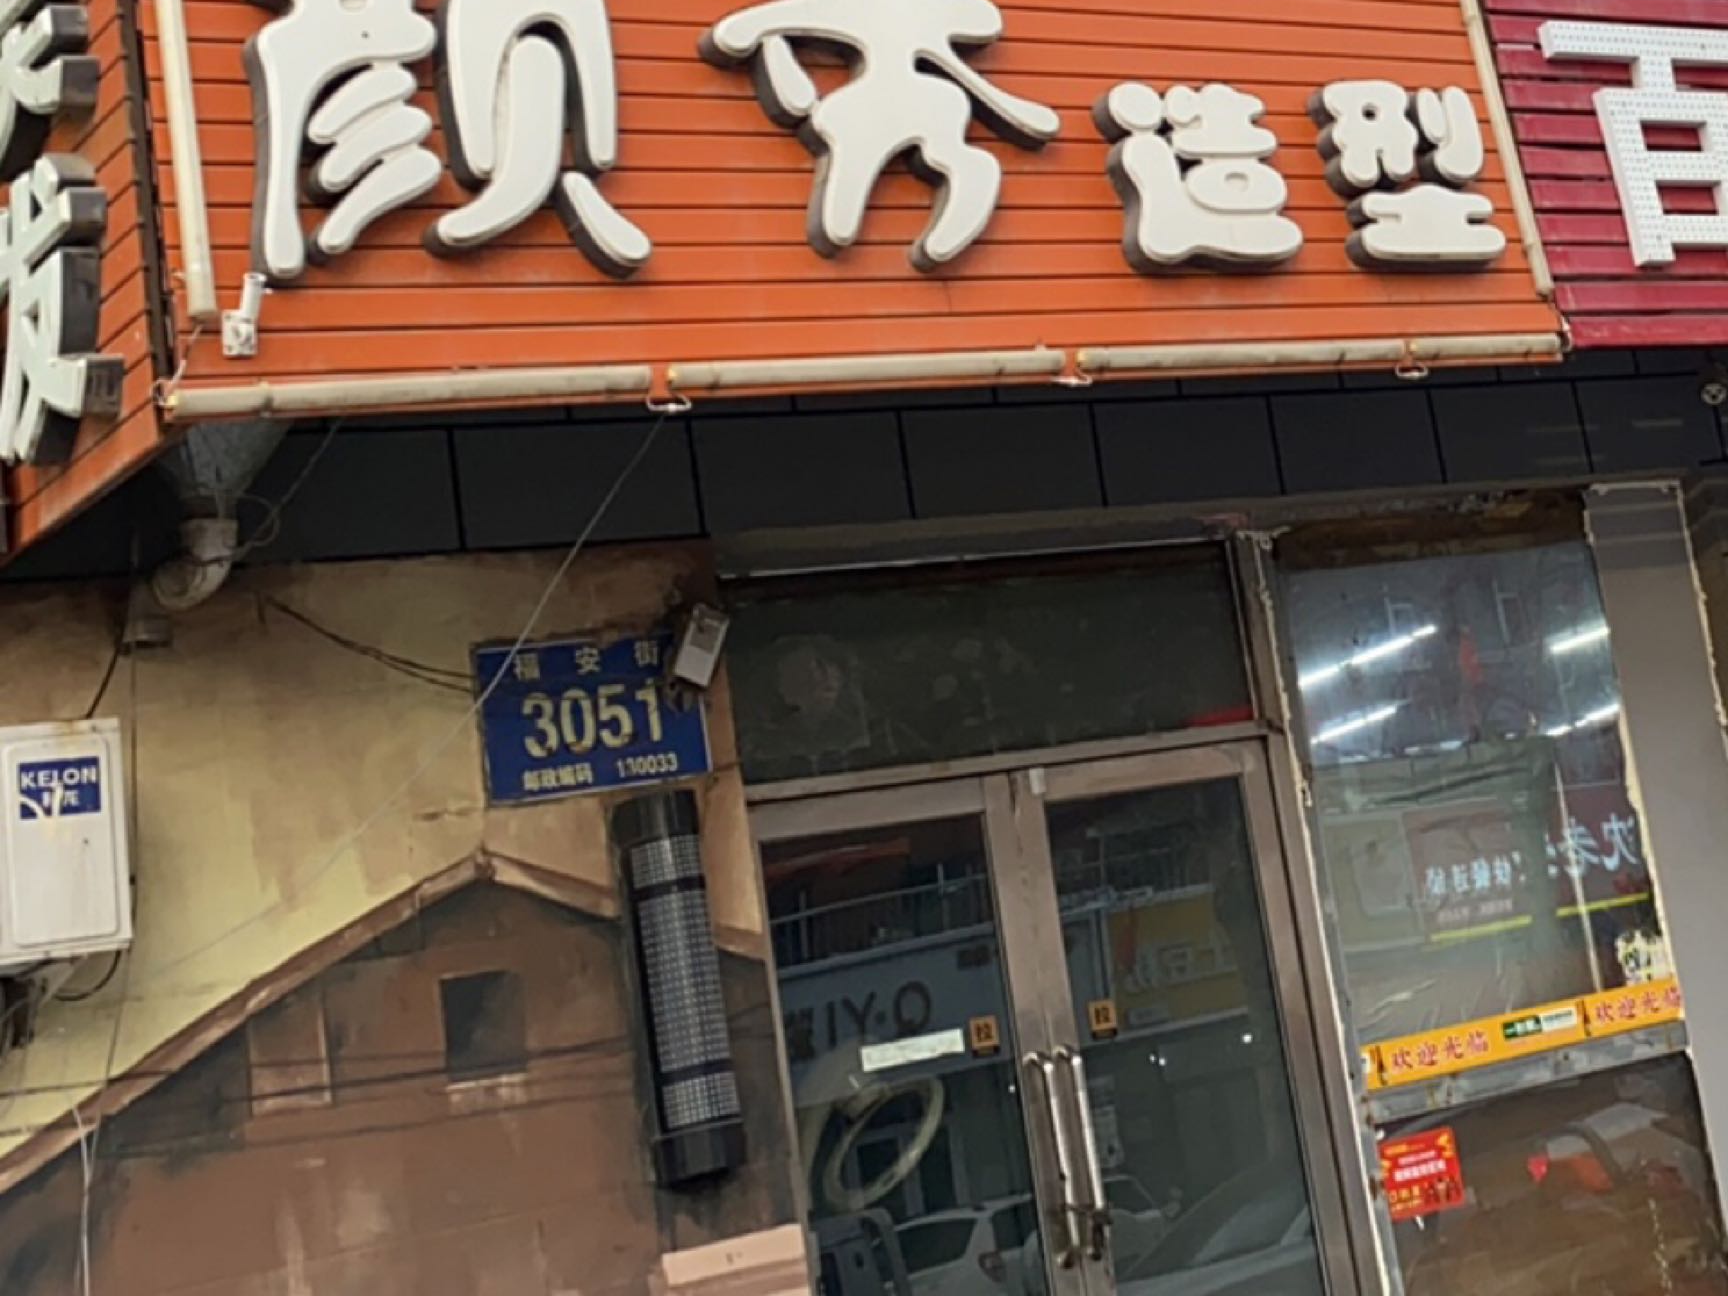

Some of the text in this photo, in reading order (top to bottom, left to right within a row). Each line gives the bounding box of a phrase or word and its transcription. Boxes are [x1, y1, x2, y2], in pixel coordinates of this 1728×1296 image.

[521, 679, 664, 759] 3051
[1391, 1029, 1489, 1071] 欢迎光临
